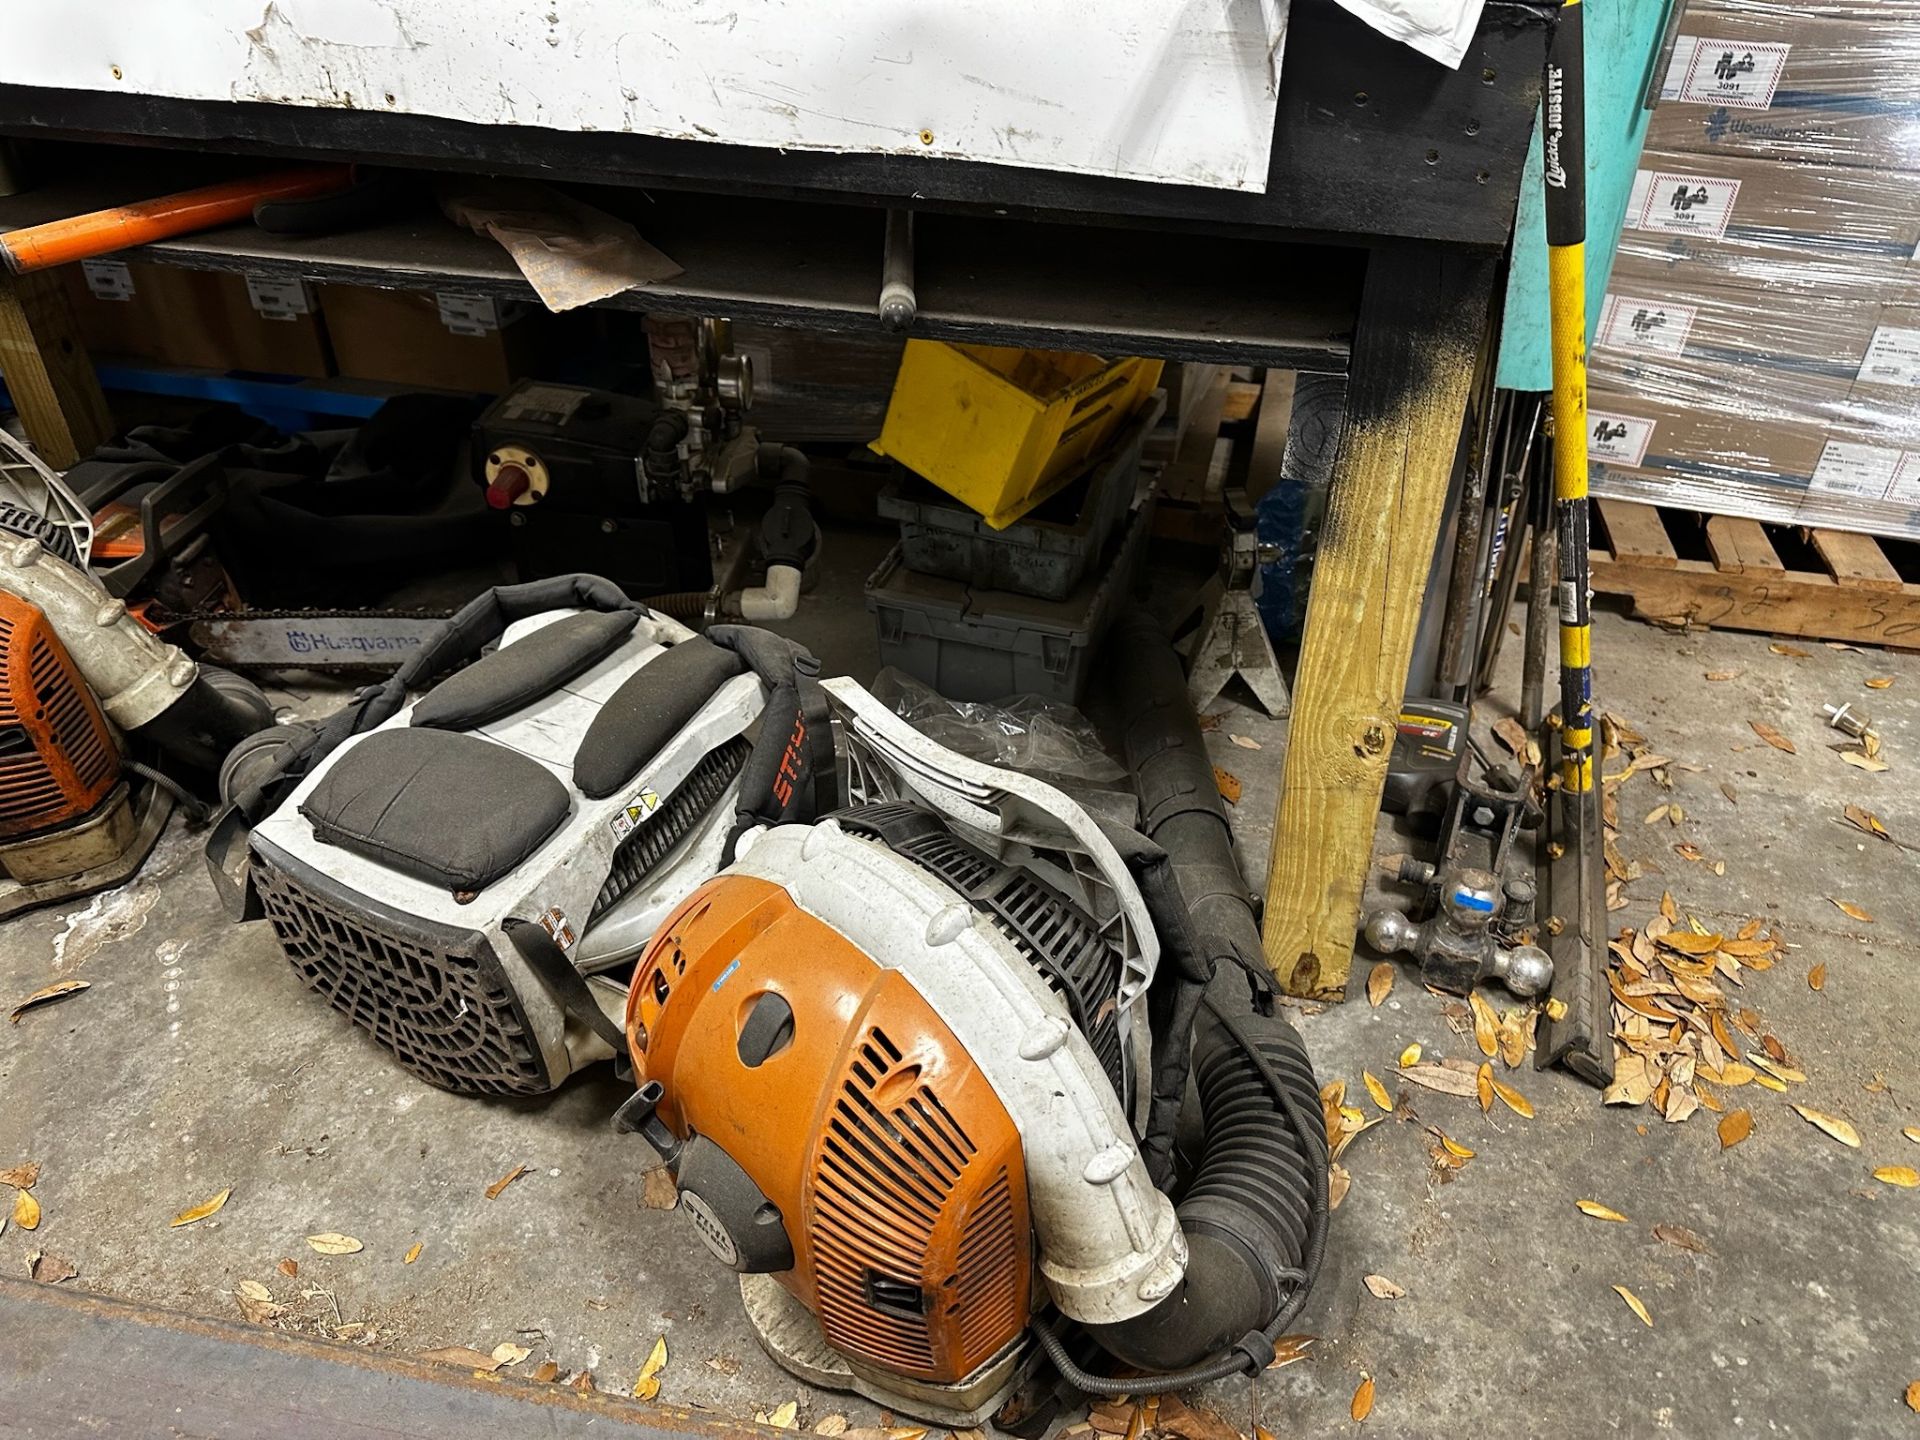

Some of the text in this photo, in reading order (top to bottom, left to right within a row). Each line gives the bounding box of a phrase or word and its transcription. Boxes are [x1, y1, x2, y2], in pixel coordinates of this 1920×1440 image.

[1548, 67, 1563, 129] JOBSITE
[1716, 81, 1740, 91] 3091
[310, 633, 421, 652] Husqvarna
[684, 1199, 731, 1250] STIHL
